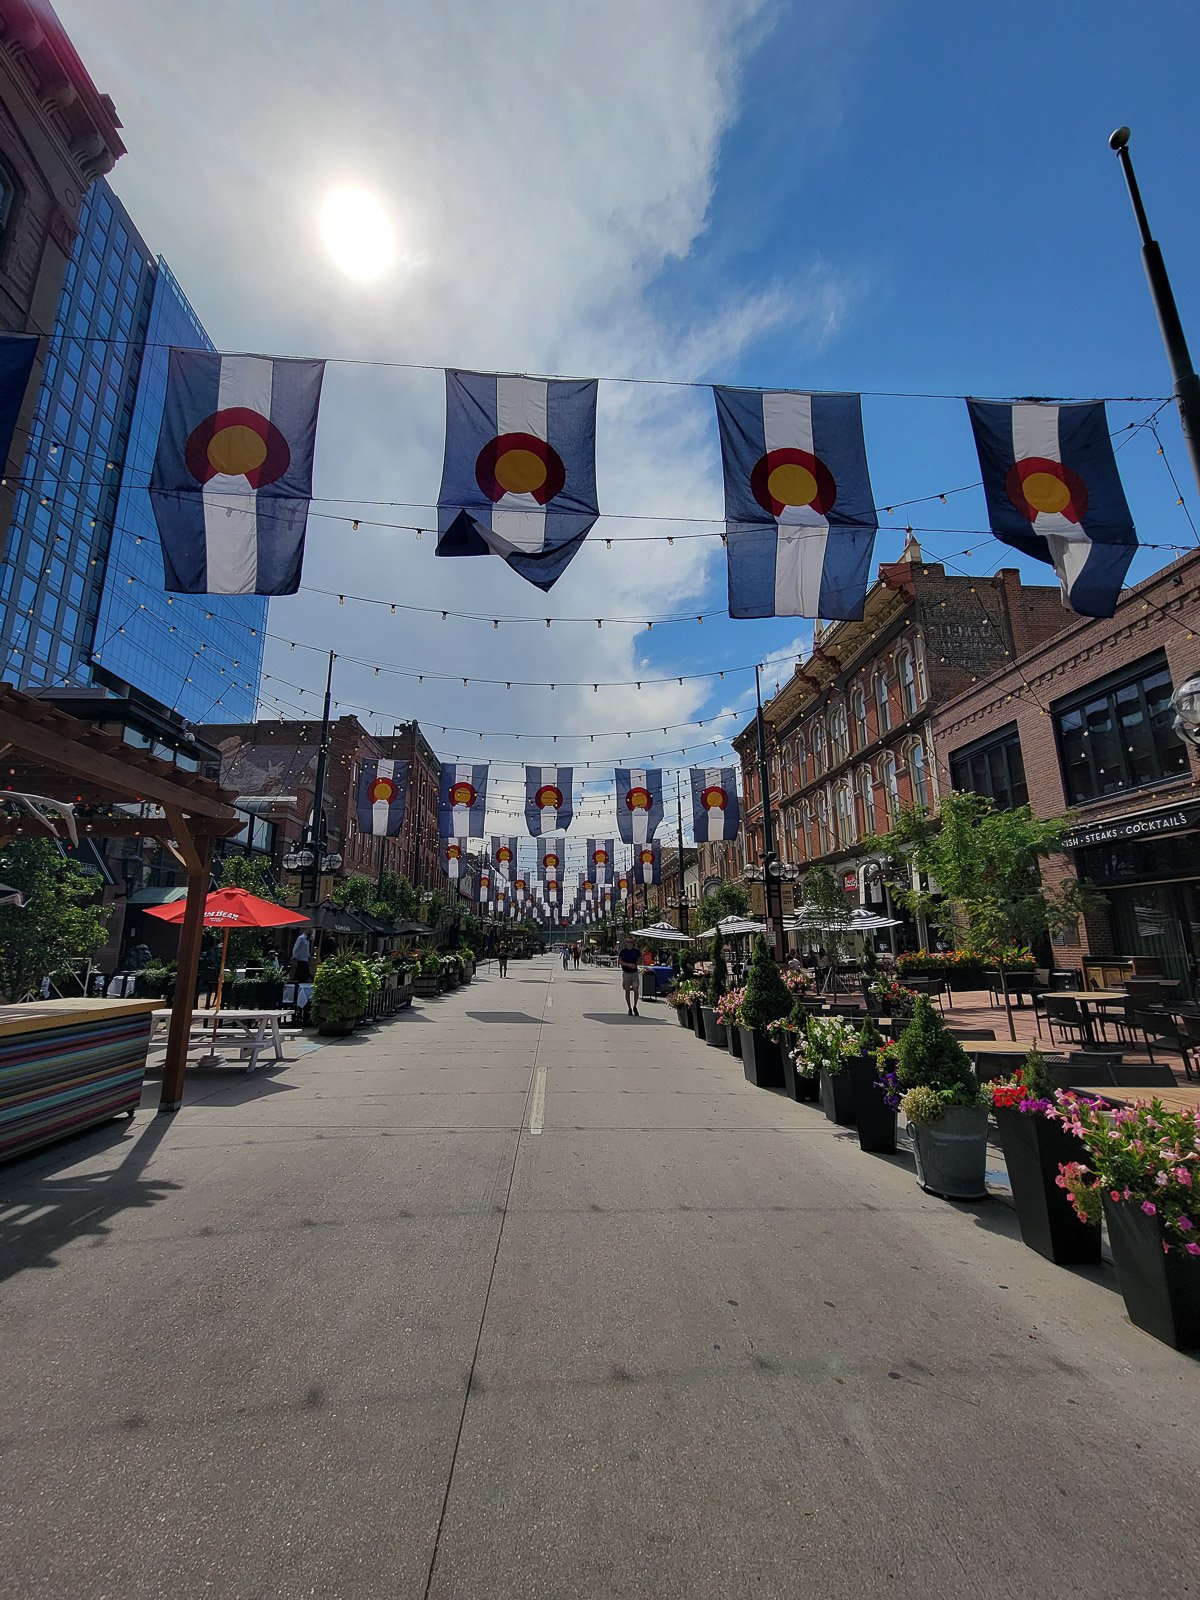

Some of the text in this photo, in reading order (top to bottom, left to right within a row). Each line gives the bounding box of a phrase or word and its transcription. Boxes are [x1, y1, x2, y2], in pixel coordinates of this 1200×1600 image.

[1085, 829, 1118, 843] STEAKS
[1125, 815, 1188, 835] COCKTAILS
[216, 910, 238, 920] BEAM
